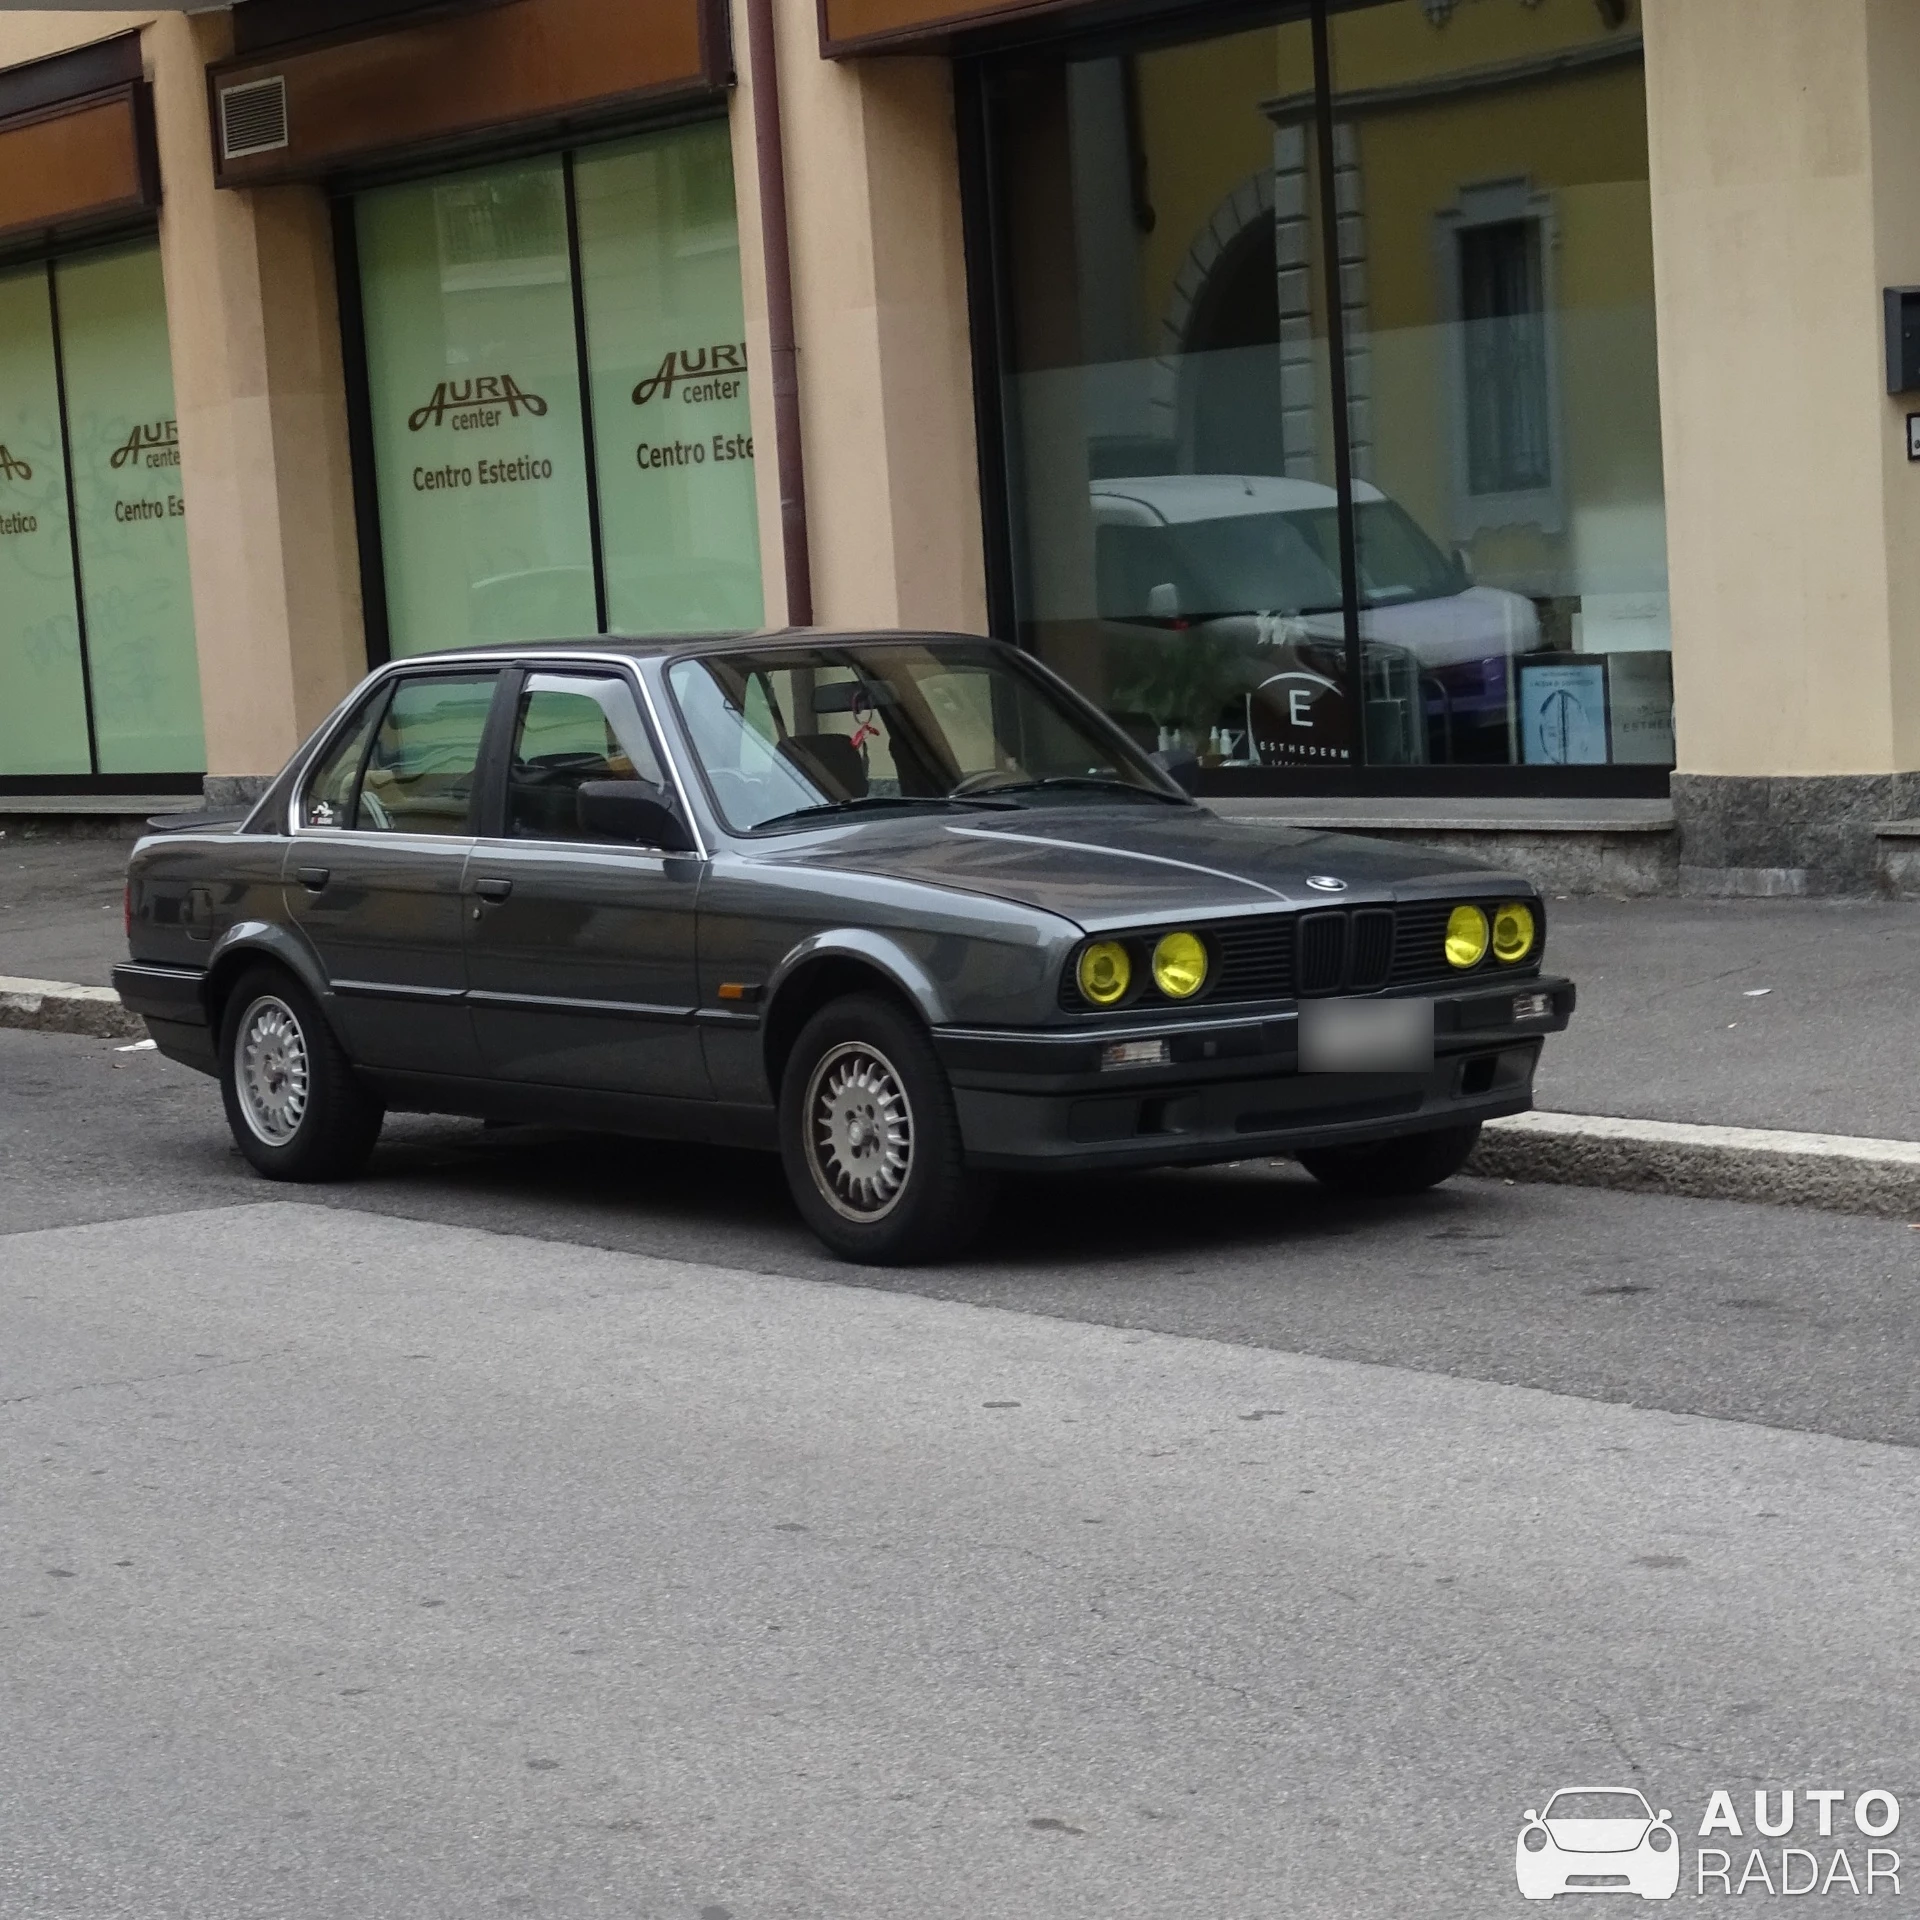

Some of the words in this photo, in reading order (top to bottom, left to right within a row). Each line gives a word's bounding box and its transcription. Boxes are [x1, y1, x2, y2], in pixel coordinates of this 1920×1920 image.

[408, 374, 548, 432] AURA
[683, 378, 740, 403] center
[452, 408, 502, 431] center
[637, 441, 705, 469] Centro
[712, 434, 754, 462] Este
[413, 465, 472, 491] Centro
[478, 455, 553, 485] Estetico
[115, 499, 164, 522] Centro
[1288, 689, 1314, 727] E
[1259, 740, 1350, 759] ESTHEDERM
